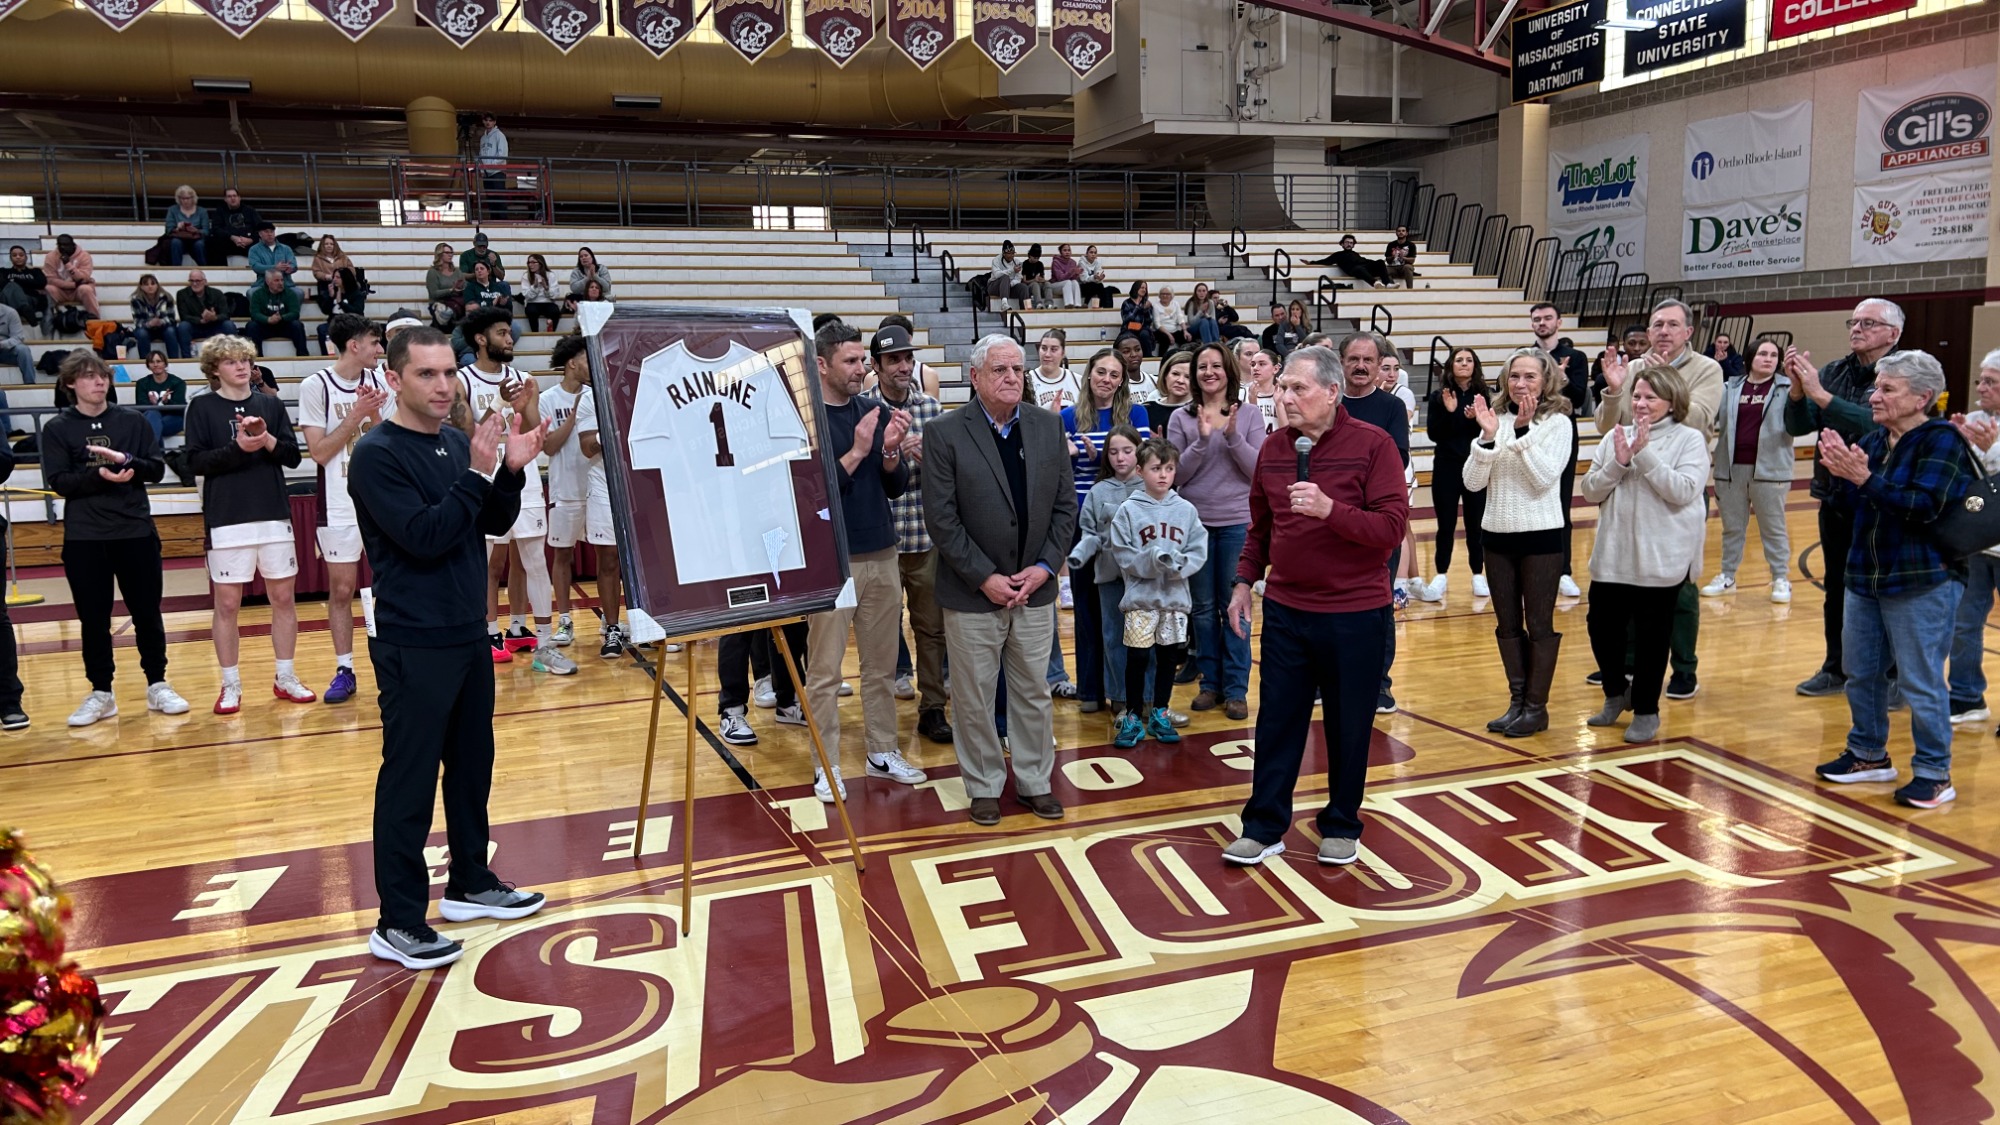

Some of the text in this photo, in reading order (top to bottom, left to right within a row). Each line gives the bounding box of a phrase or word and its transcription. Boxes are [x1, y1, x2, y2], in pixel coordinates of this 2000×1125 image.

[897, 0, 947, 23] 2004
[974, 2, 1036, 27] 1985-86
[1062, 1, 1102, 11] CHAMPIONS
[1784, 0, 1884, 24] COLLE
[1053, 8, 1112, 34] 1982-83
[1528, 3, 1590, 34] UNIVERSITY
[1658, 13, 1708, 40] STATE
[1551, 28, 1564, 41] OF
[1518, 32, 1600, 68] MASSACHUSETTS
[1637, 29, 1730, 66] UNIVERSITY
[1550, 60, 1563, 72] AT
[1528, 67, 1584, 94] DARTMOUTH
[1898, 110, 1973, 146] Gil's
[1718, 144, 1802, 169] Ortho Rhode Island
[1887, 142, 1982, 167] APPLIANCES
[1565, 155, 1637, 189] The Lot
[1915, 196, 1946, 206] MINUTE
[1947, 194, 1964, 202] OFF
[1923, 188, 1942, 197] FREE
[1566, 199, 1631, 214] Your Rhode Island Lottery
[1860, 205, 1876, 230] THIS
[1877, 200, 1901, 218] GUY'S
[1907, 206, 1942, 217] STUDENT
[1958, 200, 1990, 210] DISCOU
[1685, 206, 1803, 255] Dave's
[1920, 217, 1936, 225] OPEN
[1937, 214, 1943, 224] 7
[1932, 223, 1974, 236] 228-8188
[1616, 241, 1636, 258] CC
[1751, 236, 1801, 248] marketplace
[1871, 230, 1898, 246] PIZZA
[1684, 256, 1800, 272] Better Food, Better Service
[666, 371, 757, 410] RAINONE
[709, 402, 735, 467] 1
[1139, 522, 1185, 547] RIC
